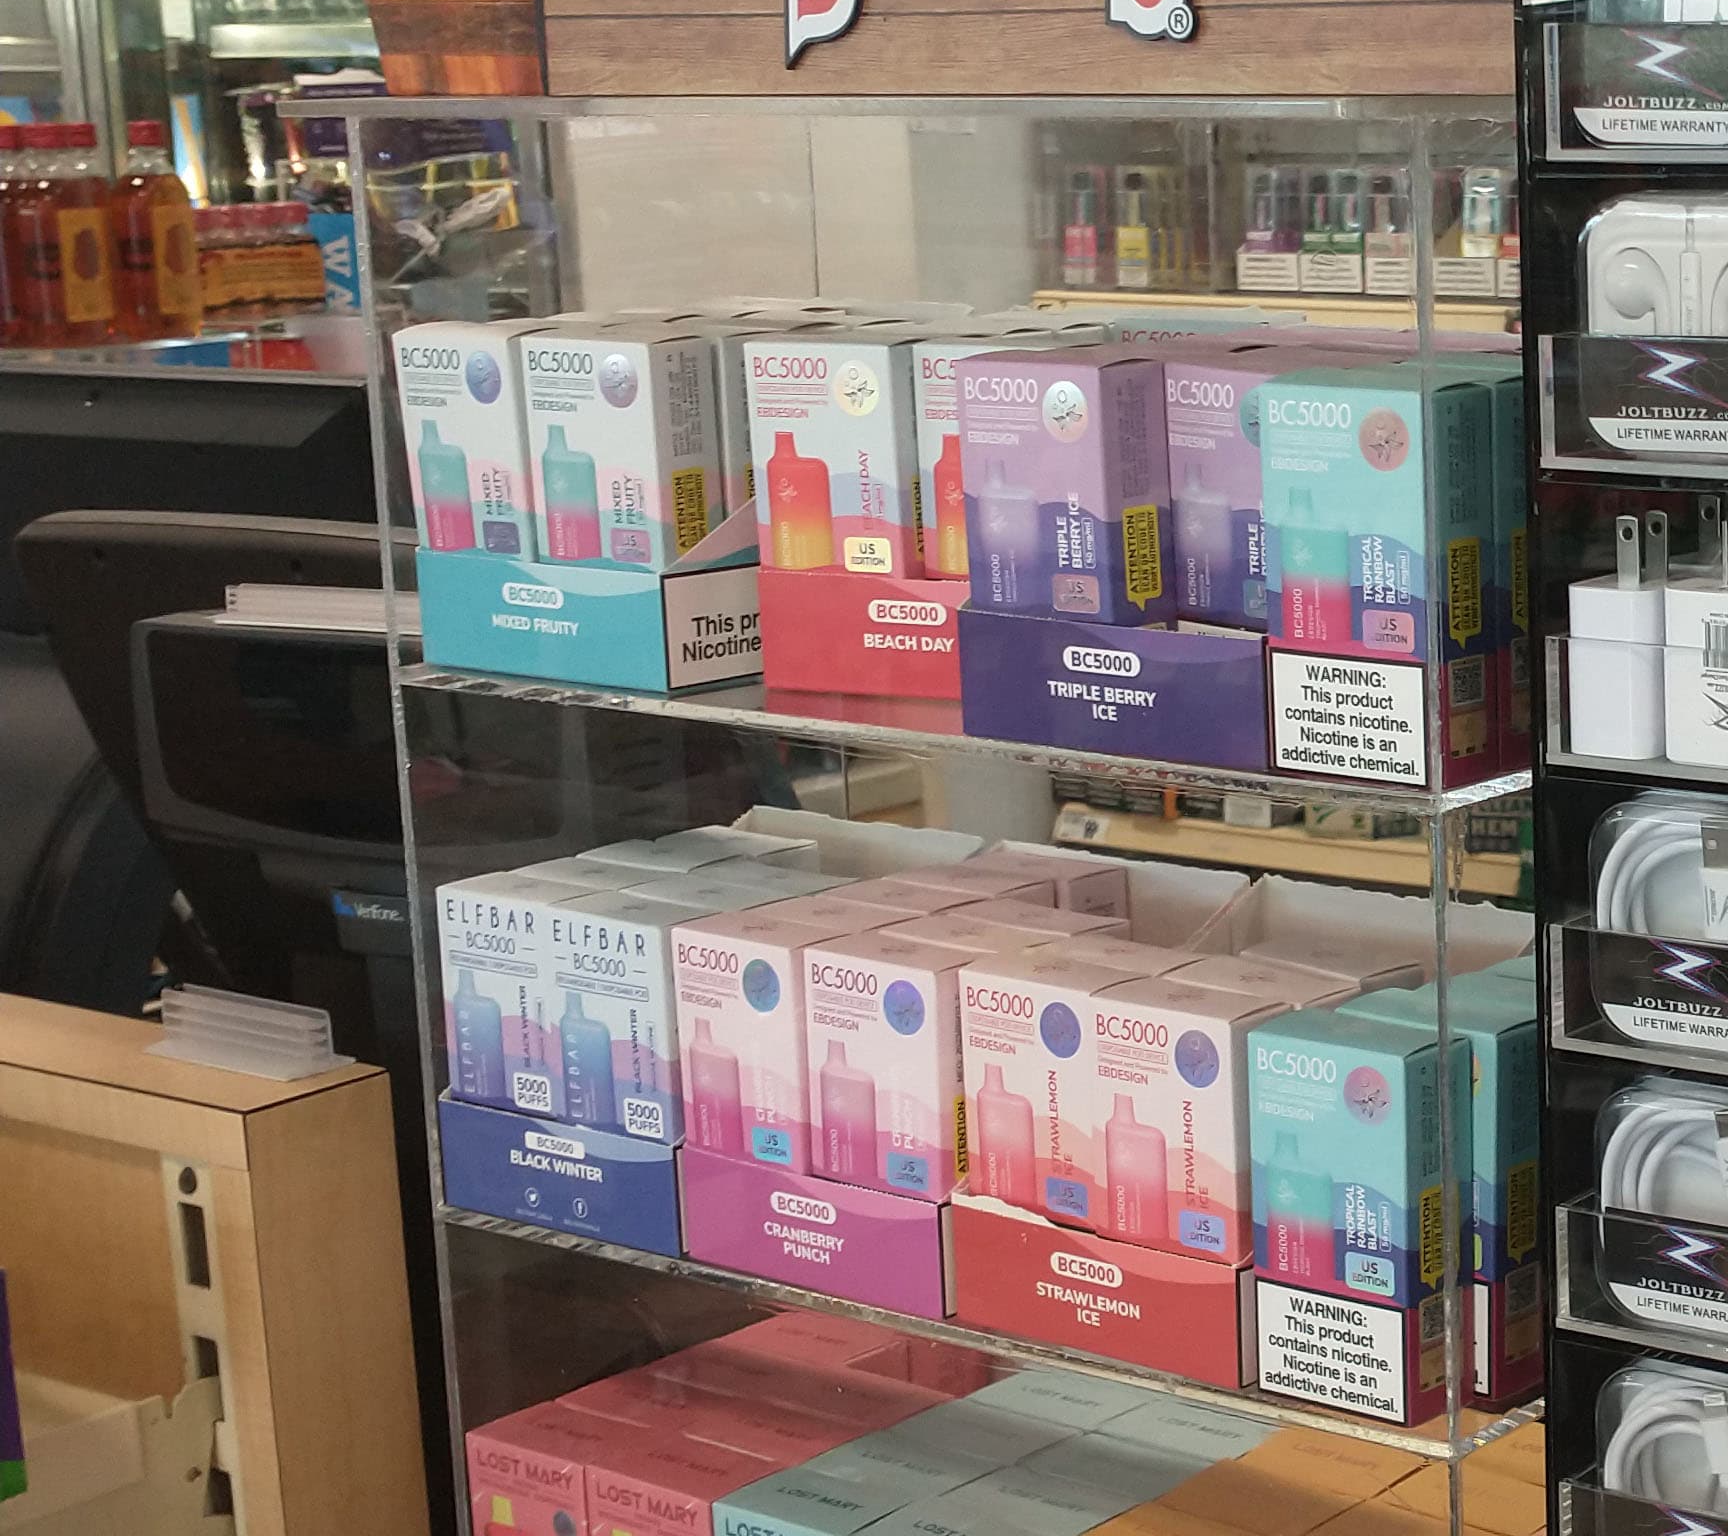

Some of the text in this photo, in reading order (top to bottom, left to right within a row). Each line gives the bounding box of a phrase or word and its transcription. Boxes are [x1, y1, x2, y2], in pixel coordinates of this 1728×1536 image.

[1601, 119, 1660, 134] LIFETIME
[752, 356, 828, 380] BC5000
[1616, 426, 1672, 442] LIFETIME
[492, 614, 579, 637] MIXED FRUITY
[682, 634, 762, 665] Nicotine
[864, 633, 954, 653] BEACH DAY
[1070, 650, 1134, 674] BC5000
[1304, 664, 1388, 689] WARNING:
[1047, 680, 1156, 708] TRIPLE BERRY
[1300, 686, 1394, 712] This product
[1092, 703, 1118, 722] ICE
[1284, 705, 1414, 736] contains nicotine.
[1300, 726, 1398, 753] Nicotine is an
[1281, 745, 1420, 778] addictive chemical.
[445, 898, 535, 936] ELFBAR
[517, 1092, 550, 1109] PUFFS
[510, 1150, 603, 1184] BLACK WINTER
[764, 1221, 844, 1252] CRANBERRY
[783, 1240, 831, 1265] PUNCH
[1058, 1255, 1116, 1285] BC5000
[1036, 1281, 1141, 1321] STRAWLEMON
